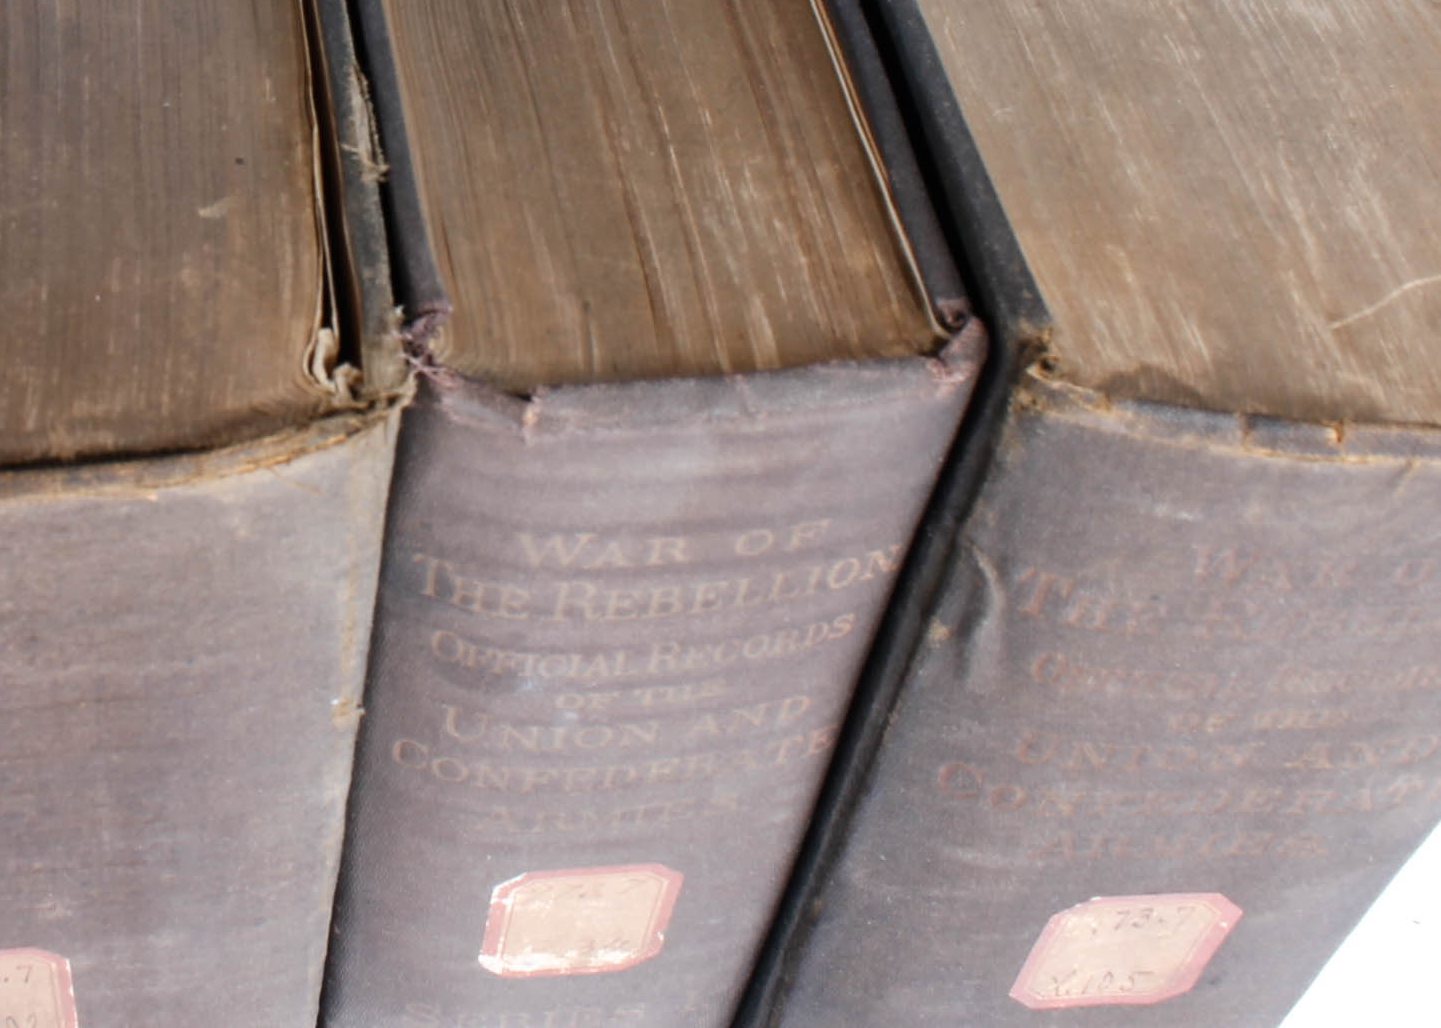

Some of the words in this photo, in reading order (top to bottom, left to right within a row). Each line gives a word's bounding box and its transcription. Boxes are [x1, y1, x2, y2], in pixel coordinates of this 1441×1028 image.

[518, 532, 693, 569] WAR
[734, 518, 833, 557] OF
[411, 552, 533, 622] THE
[550, 544, 901, 623] REBELLION
[430, 628, 641, 681] OFFICIAL
[647, 612, 856, 676] RECORDS
[442, 703, 665, 753] UNION
[686, 694, 813, 740] AND
[391, 724, 839, 795] CONFEDERATE
